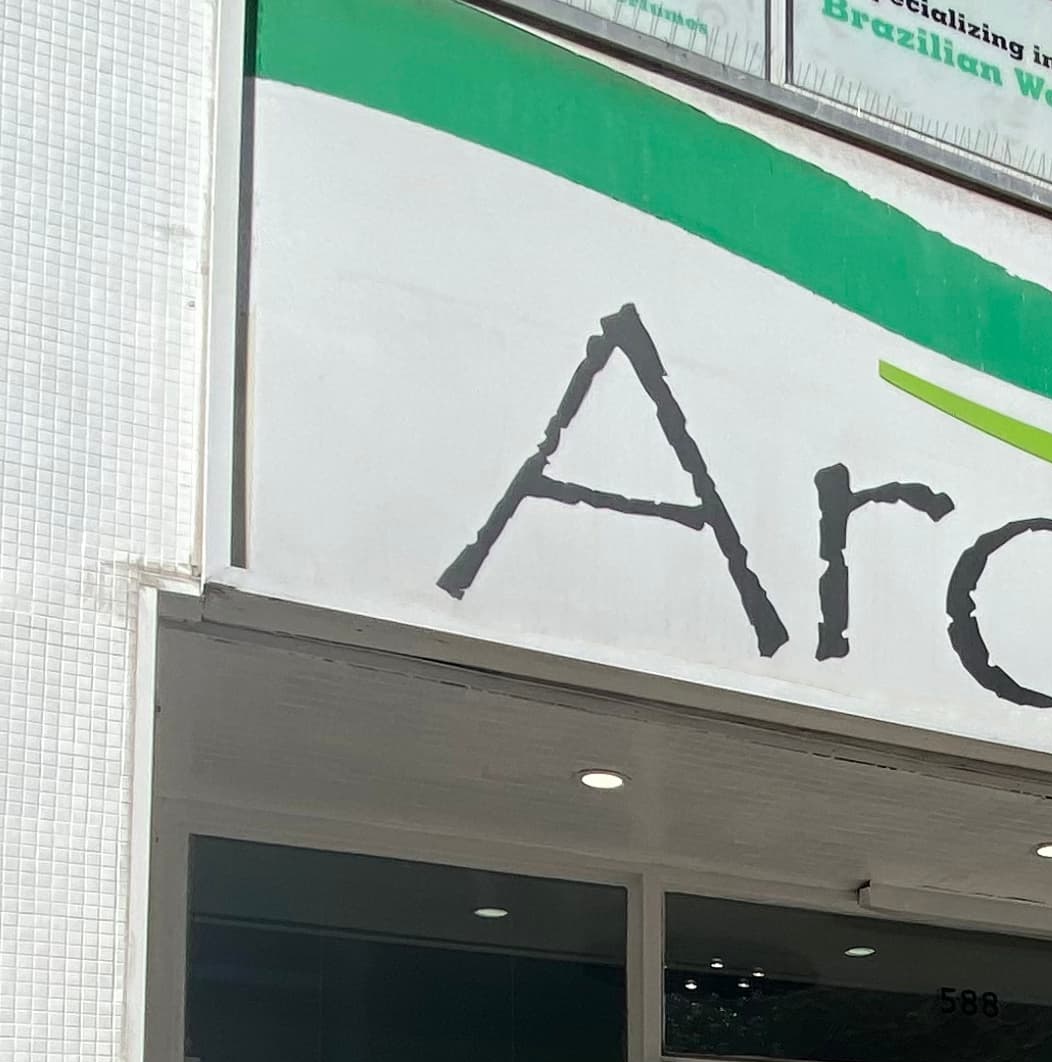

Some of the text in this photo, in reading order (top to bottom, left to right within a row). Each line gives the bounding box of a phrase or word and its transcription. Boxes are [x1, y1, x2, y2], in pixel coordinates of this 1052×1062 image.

[822, 0, 1003, 86] Brazilian
[872, 0, 1024, 60] cializing
[941, 987, 999, 1017] 588
